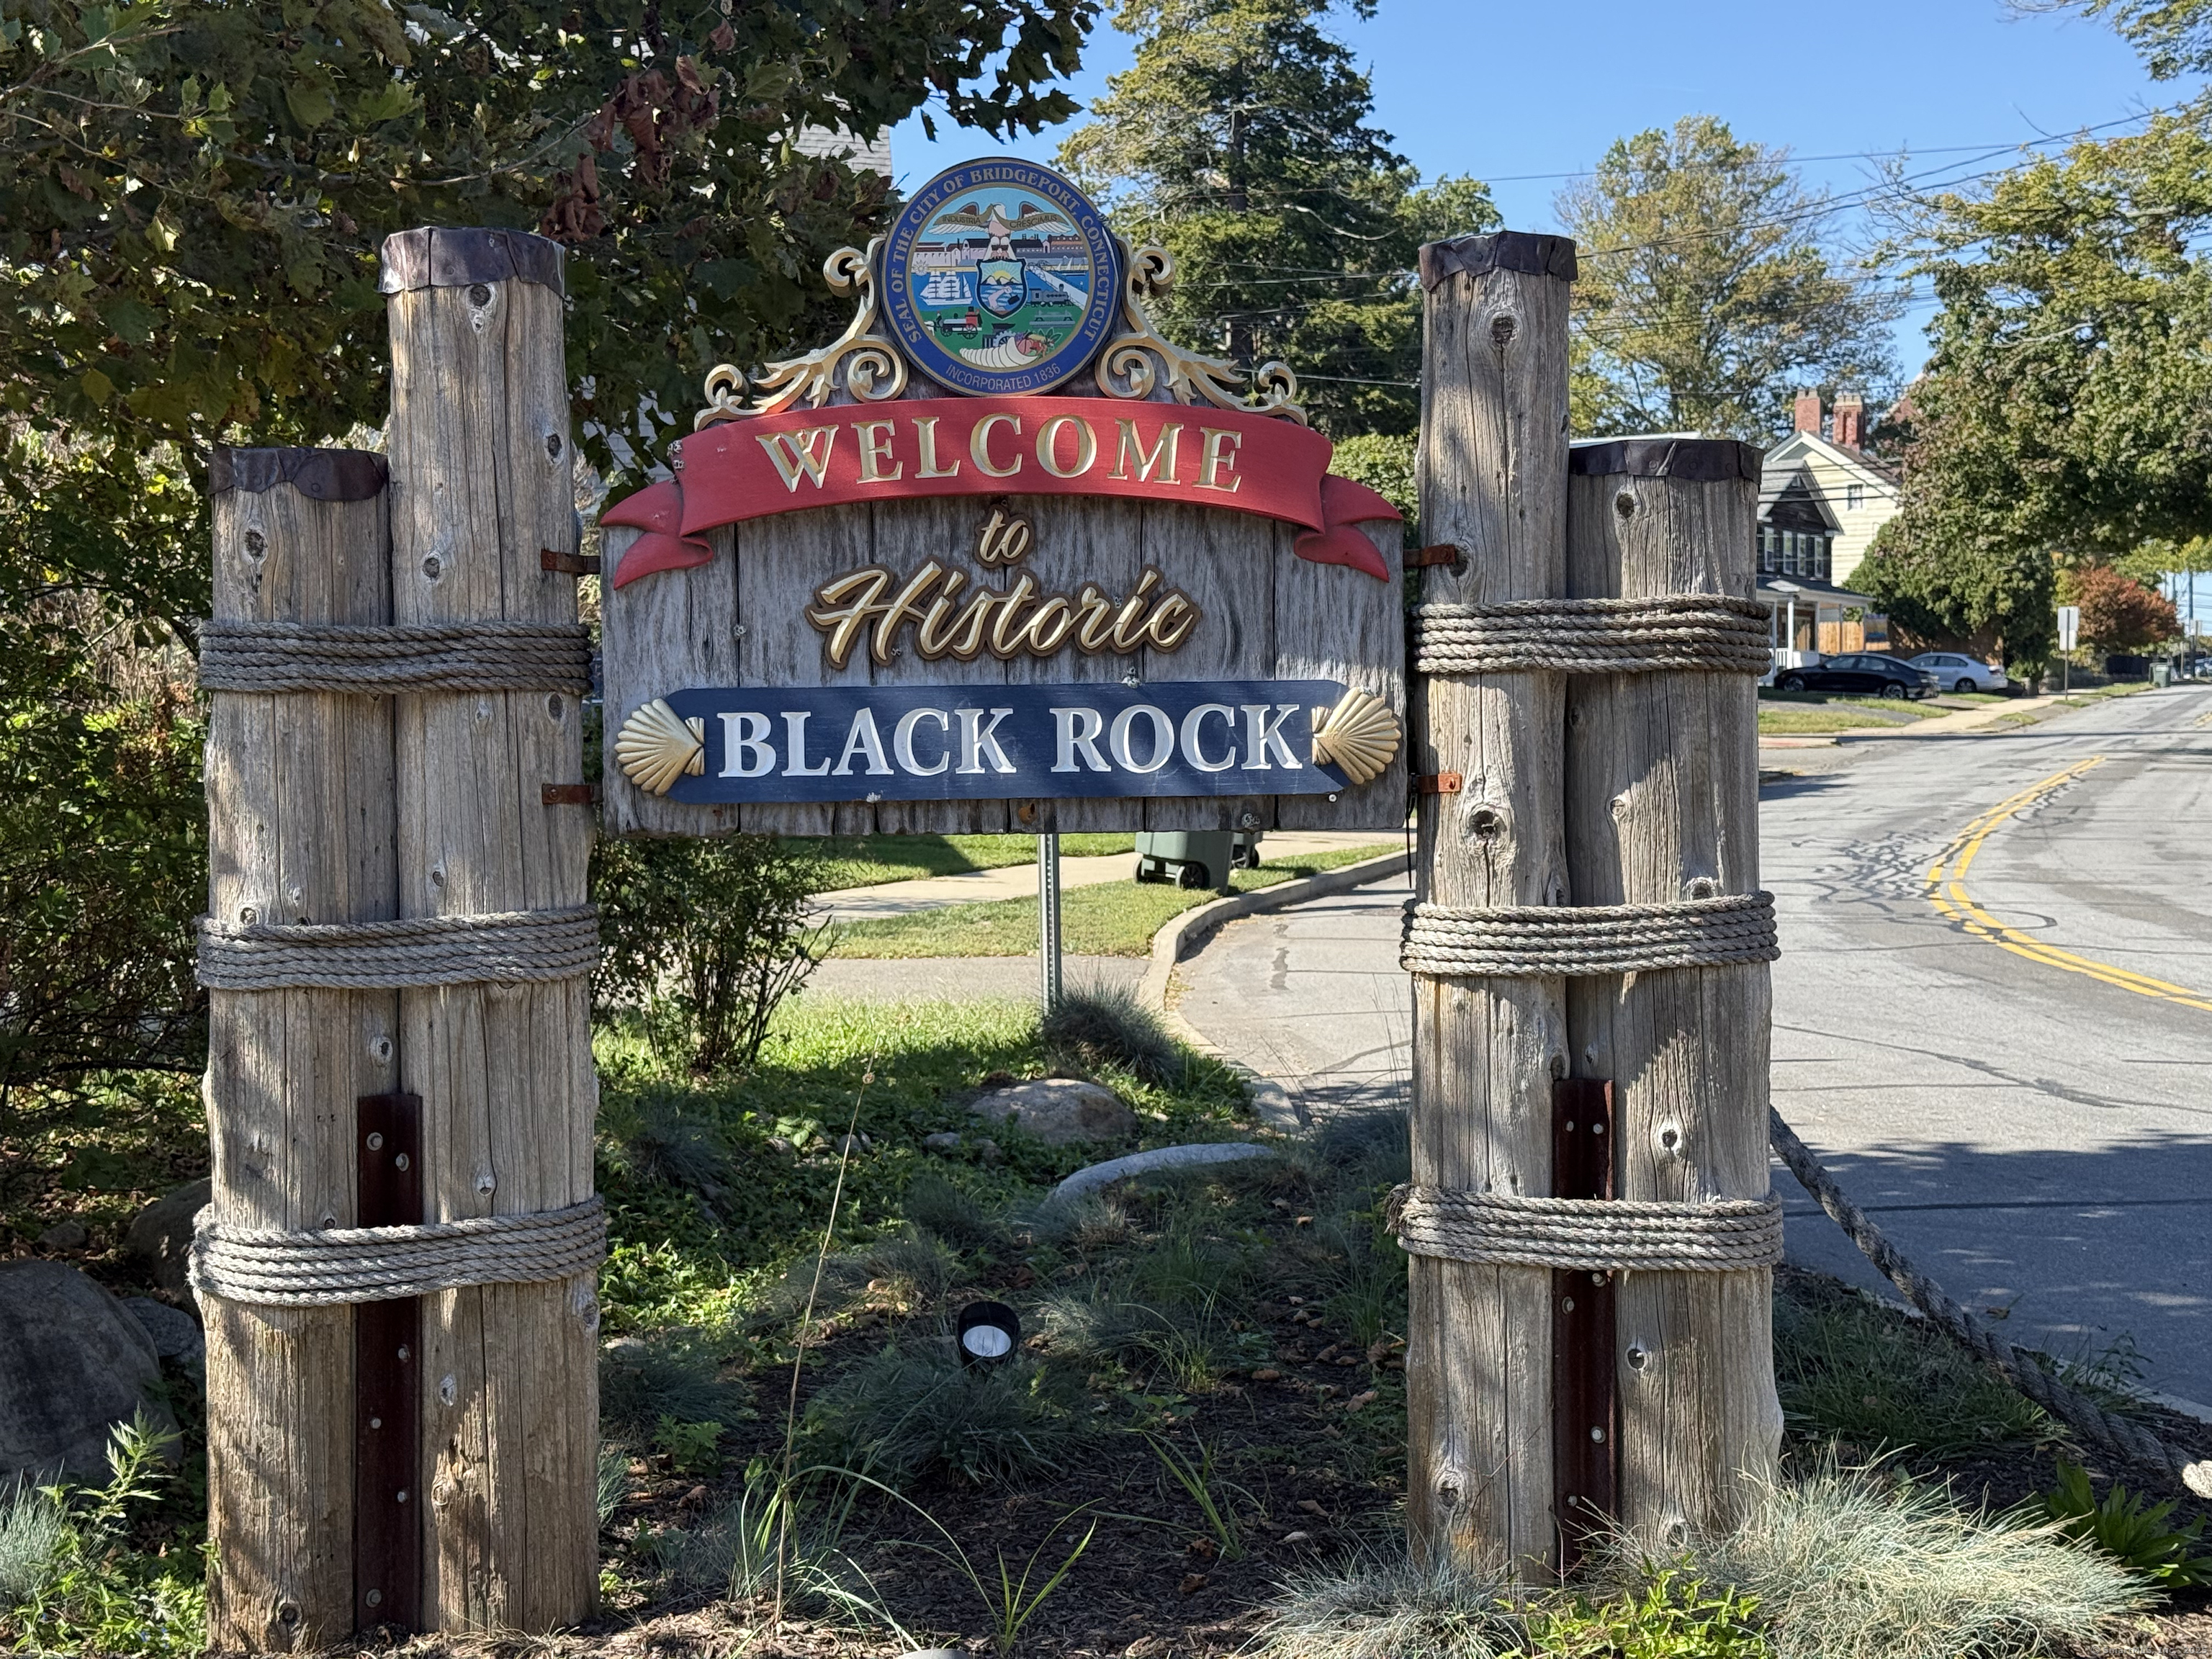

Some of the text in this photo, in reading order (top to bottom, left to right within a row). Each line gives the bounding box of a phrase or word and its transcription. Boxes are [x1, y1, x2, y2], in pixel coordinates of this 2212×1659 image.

[891, 166, 1109, 343] SEAL OF THE CITY OF BRIDGEPORT, CONNECTICUT
[942, 215, 1057, 228] INDUSTRIA CRESCIMUS
[946, 364, 1061, 391] INCORPORATED 1836
[756, 413, 1244, 493] WELCOME
[981, 510, 1031, 566] to
[811, 559, 1195, 667] Historic
[718, 703, 1304, 778] BLACK ROCK
